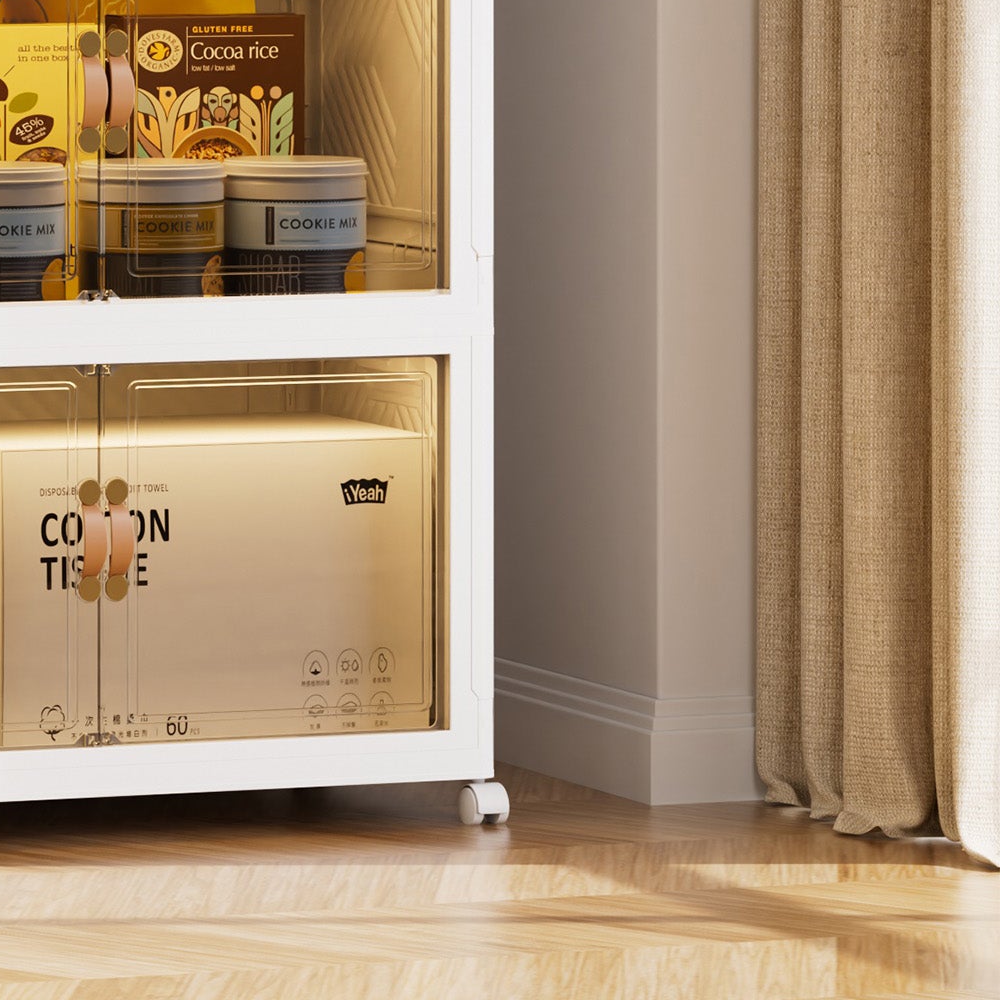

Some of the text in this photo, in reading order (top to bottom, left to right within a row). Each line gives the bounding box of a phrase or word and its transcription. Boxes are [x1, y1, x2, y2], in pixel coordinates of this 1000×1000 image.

[231, 25, 253, 33] FREE
[190, 41, 279, 60] Cocoa rice
[225, 64, 236, 72] salt
[15, 117, 44, 136] 45%
[35, 224, 56, 235] MIX
[137, 220, 214, 233] COOKIE MIX
[279, 217, 358, 230] COOKIE MIX
[144, 483, 169, 492] TOWEL
[344, 483, 384, 503] iYeah
[41, 509, 170, 547] COON
[40, 553, 148, 590] TISE
[166, 715, 188, 736] 60
